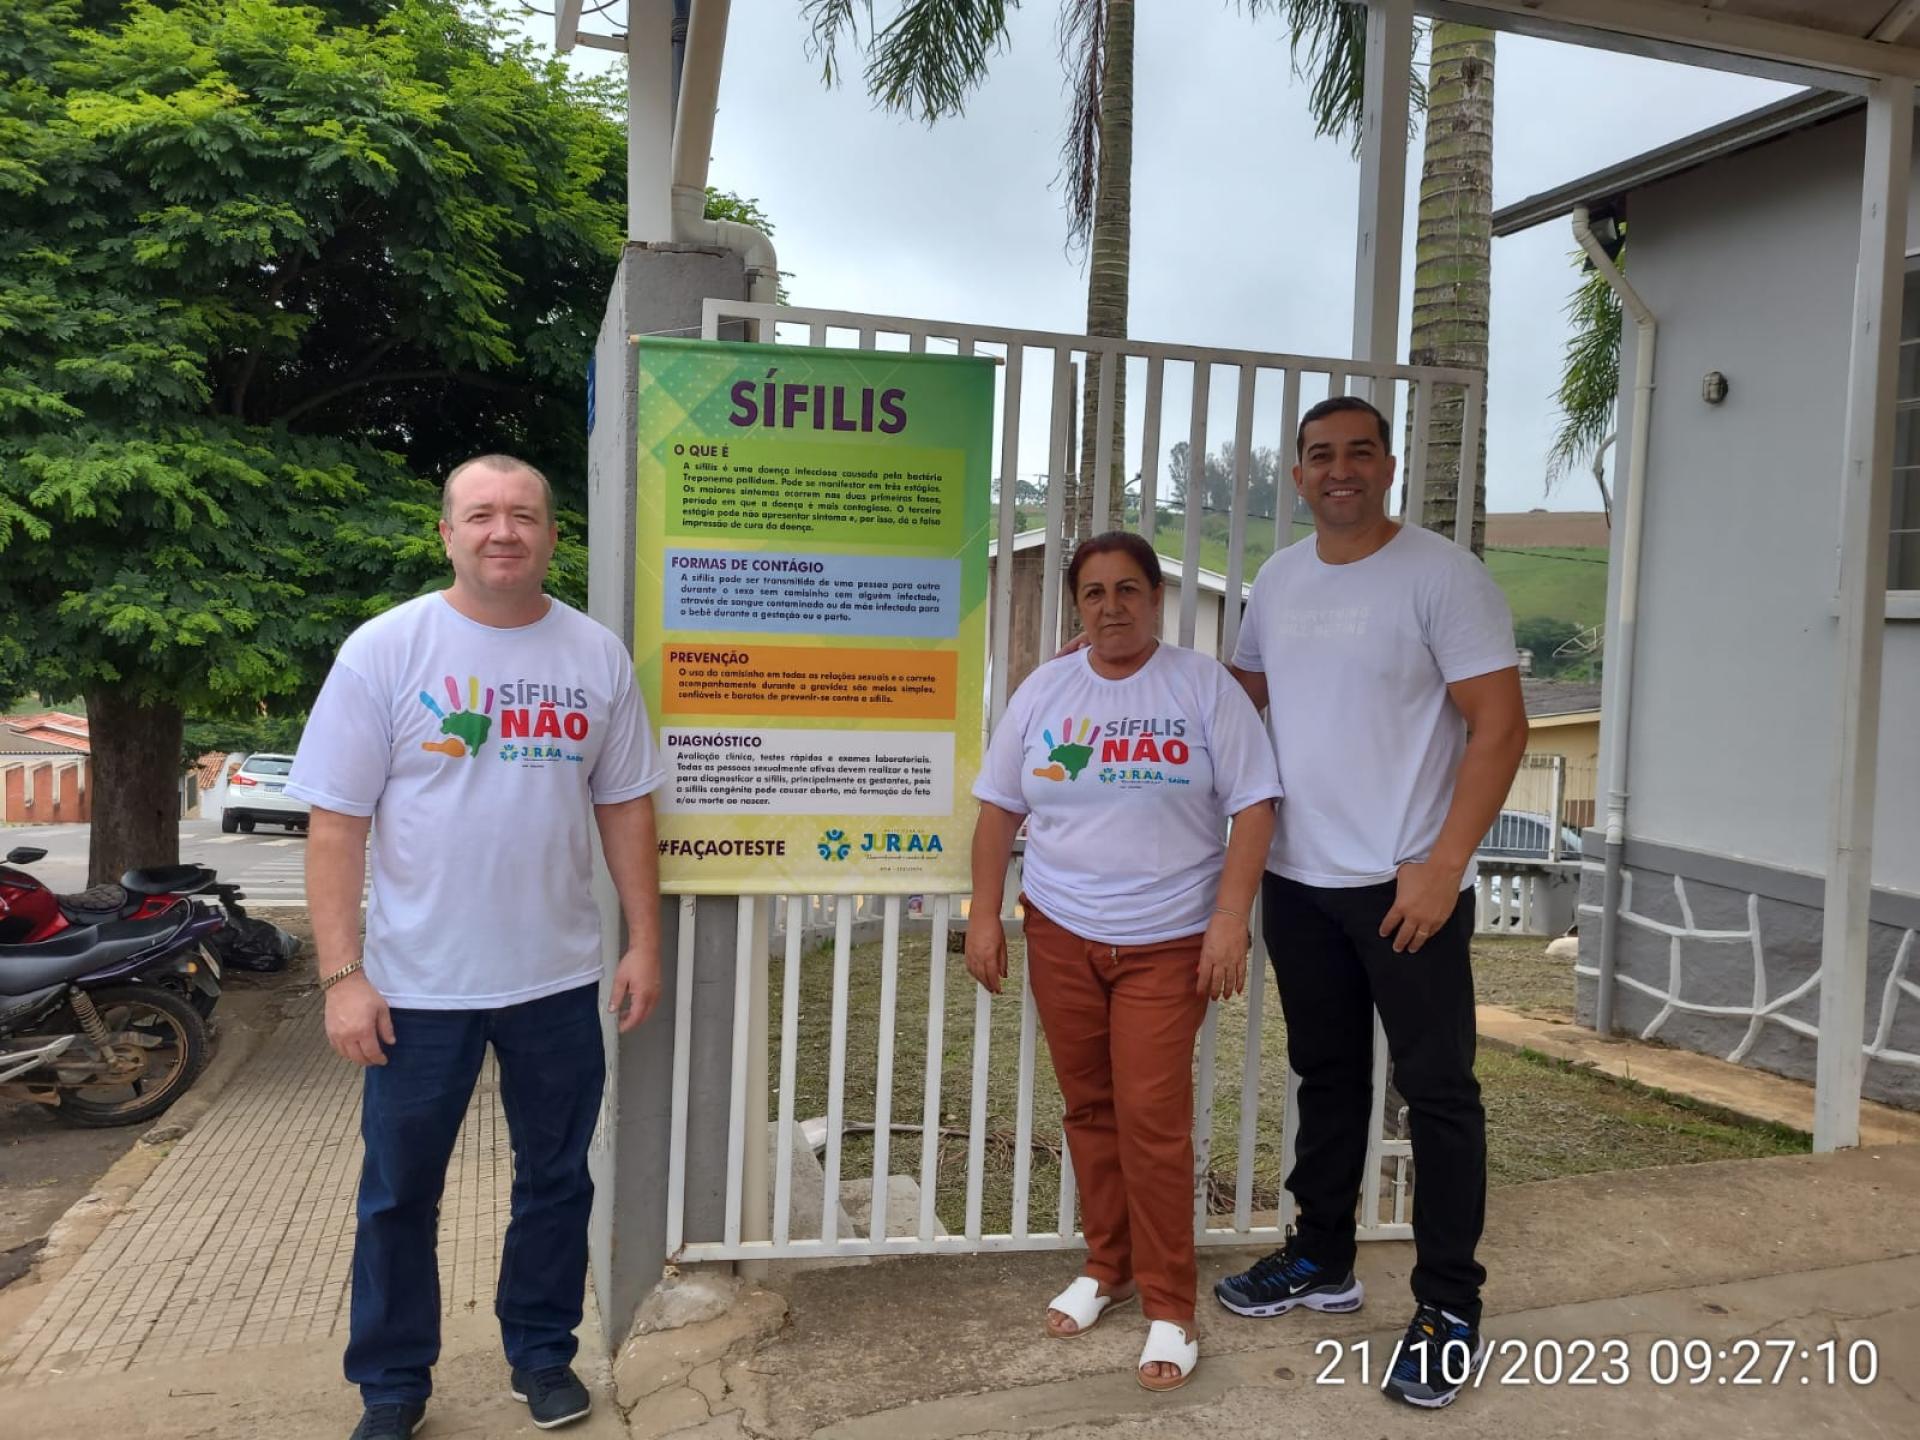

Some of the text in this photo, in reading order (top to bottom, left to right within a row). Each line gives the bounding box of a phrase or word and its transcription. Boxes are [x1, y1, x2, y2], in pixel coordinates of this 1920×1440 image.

[729, 368, 907, 434] SÍFILIS
[674, 443, 729, 457] O QUE É
[695, 462, 718, 471] sífilis
[758, 465, 790, 476] doença
[795, 466, 837, 476] infecciosa
[842, 469, 878, 478] causada
[883, 470, 902, 480] pela
[907, 471, 942, 481] bactéria
[683, 472, 733, 483] Treponema
[736, 475, 778, 485] pallidum.
[781, 477, 802, 486] Pode
[818, 479, 866, 489] manifestar
[885, 481, 901, 490] três
[700, 485, 736, 495] maiores
[740, 487, 779, 496] sintomas
[846, 491, 866, 500] duas
[871, 492, 913, 502] primeiras
[682, 496, 717, 506] período
[740, 500, 756, 508] que
[772, 499, 804, 510] doença
[818, 502, 838, 510] mais
[909, 505, 941, 514] terceiro
[682, 507, 714, 518] estágio
[718, 509, 739, 518] pode
[742, 509, 759, 518] não
[762, 511, 808, 520] apresentar
[860, 516, 875, 524] por
[877, 515, 895, 525] isso,
[919, 516, 941, 525] falsa
[682, 518, 728, 528] impressão
[744, 522, 763, 530] cura
[780, 522, 814, 533] doença.
[671, 557, 824, 573] FORMAS DE CONTÁGIO
[692, 573, 715, 582] sífilis
[719, 574, 742, 584] pode
[857, 581, 888, 589] pessoa
[892, 582, 913, 590] para
[916, 581, 940, 590] outra
[681, 585, 717, 594] durante
[784, 588, 829, 597] camisinha
[858, 590, 891, 601] alguém
[680, 597, 714, 606] através
[731, 600, 763, 608] sangue
[919, 605, 939, 614] para
[689, 607, 711, 616] bebê
[714, 608, 750, 618] durante
[760, 610, 800, 621] gestação
[824, 612, 851, 622] parto.
[670, 650, 749, 667] PREVENÇÃO
[721, 669, 764, 678] camisinha
[783, 670, 806, 679] todas
[820, 671, 856, 682] relações
[858, 672, 889, 681] sexuais
[500, 679, 588, 709] SÍFILIS
[678, 680, 756, 690] acompanhamento
[762, 681, 795, 690] durante
[810, 682, 848, 692] gravidez
[852, 683, 867, 692] são
[872, 684, 896, 692] meios
[678, 690, 721, 699] confiáveis
[731, 691, 765, 700] baratos
[832, 693, 859, 702] contra
[501, 702, 589, 741] NÃO
[1104, 717, 1186, 737] SÍFILIS
[668, 732, 762, 747] DIAGNÓSTICO
[1102, 733, 1189, 765] NÃO
[677, 752, 720, 762] Avaliação
[760, 753, 785, 761] testes
[790, 753, 822, 763] rápidos
[717, 765, 751, 773] pessoas
[754, 764, 807, 772] sexualmente
[810, 764, 835, 773] ativas
[838, 764, 865, 773] devem
[868, 765, 901, 773] realizar
[911, 765, 931, 774] teste
[676, 775, 698, 783] para
[700, 774, 753, 784] diagnosticar
[791, 775, 855, 785] principalmente
[914, 776, 930, 786] pois
[685, 784, 707, 793] sífilis
[755, 785, 776, 795] pode
[810, 786, 841, 796] aborto,
[860, 786, 898, 797] formação
[914, 787, 930, 795] feto
[699, 796, 724, 804] morte
[658, 839, 785, 860] #FAÇAOTESTE
